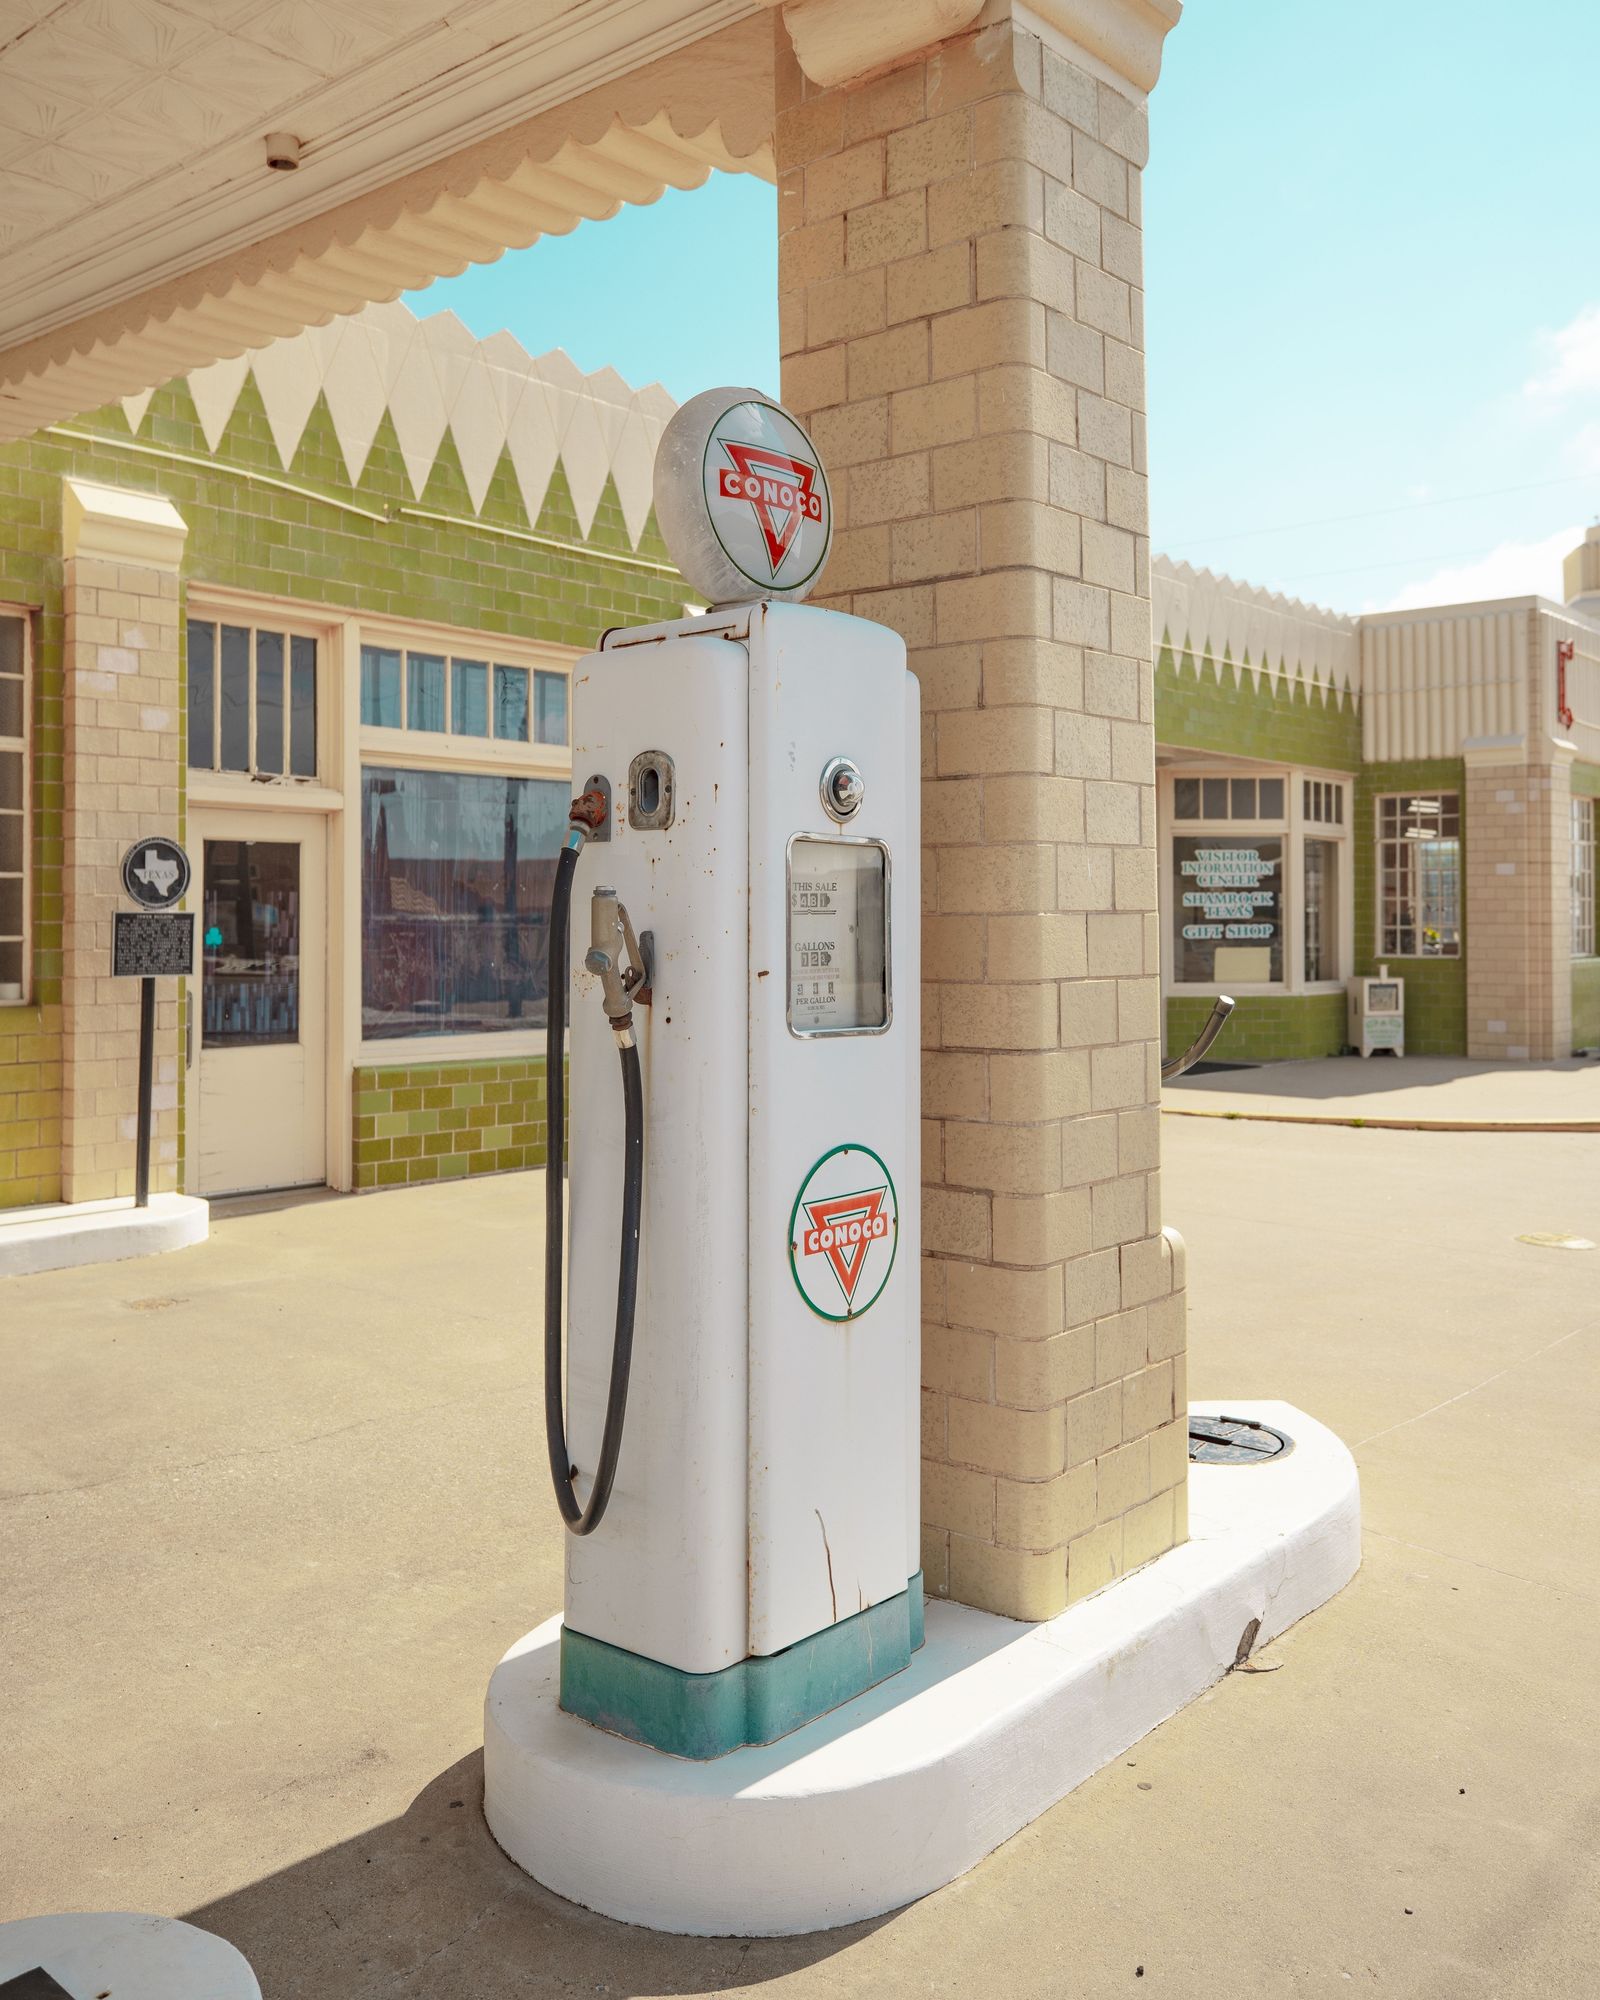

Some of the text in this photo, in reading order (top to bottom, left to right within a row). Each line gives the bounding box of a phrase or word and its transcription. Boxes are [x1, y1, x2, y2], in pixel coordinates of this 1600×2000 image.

[724, 473, 820, 517] CONOCO
[1195, 850, 1259, 862] VISITOR
[143, 869, 175, 879] TEXAS
[1182, 862, 1274, 874] INFORMATION
[1197, 874, 1259, 886] CENTER
[792, 882, 838, 892] THIS SALE
[1183, 893, 1273, 906] SHAMROCK
[1205, 905, 1254, 918] TEXAS
[1183, 925, 1274, 939] GIFT SHOP
[794, 941, 836, 951] GALLONS
[809, 995, 836, 1005] GALLON
[808, 1216, 885, 1251] CONOCO
